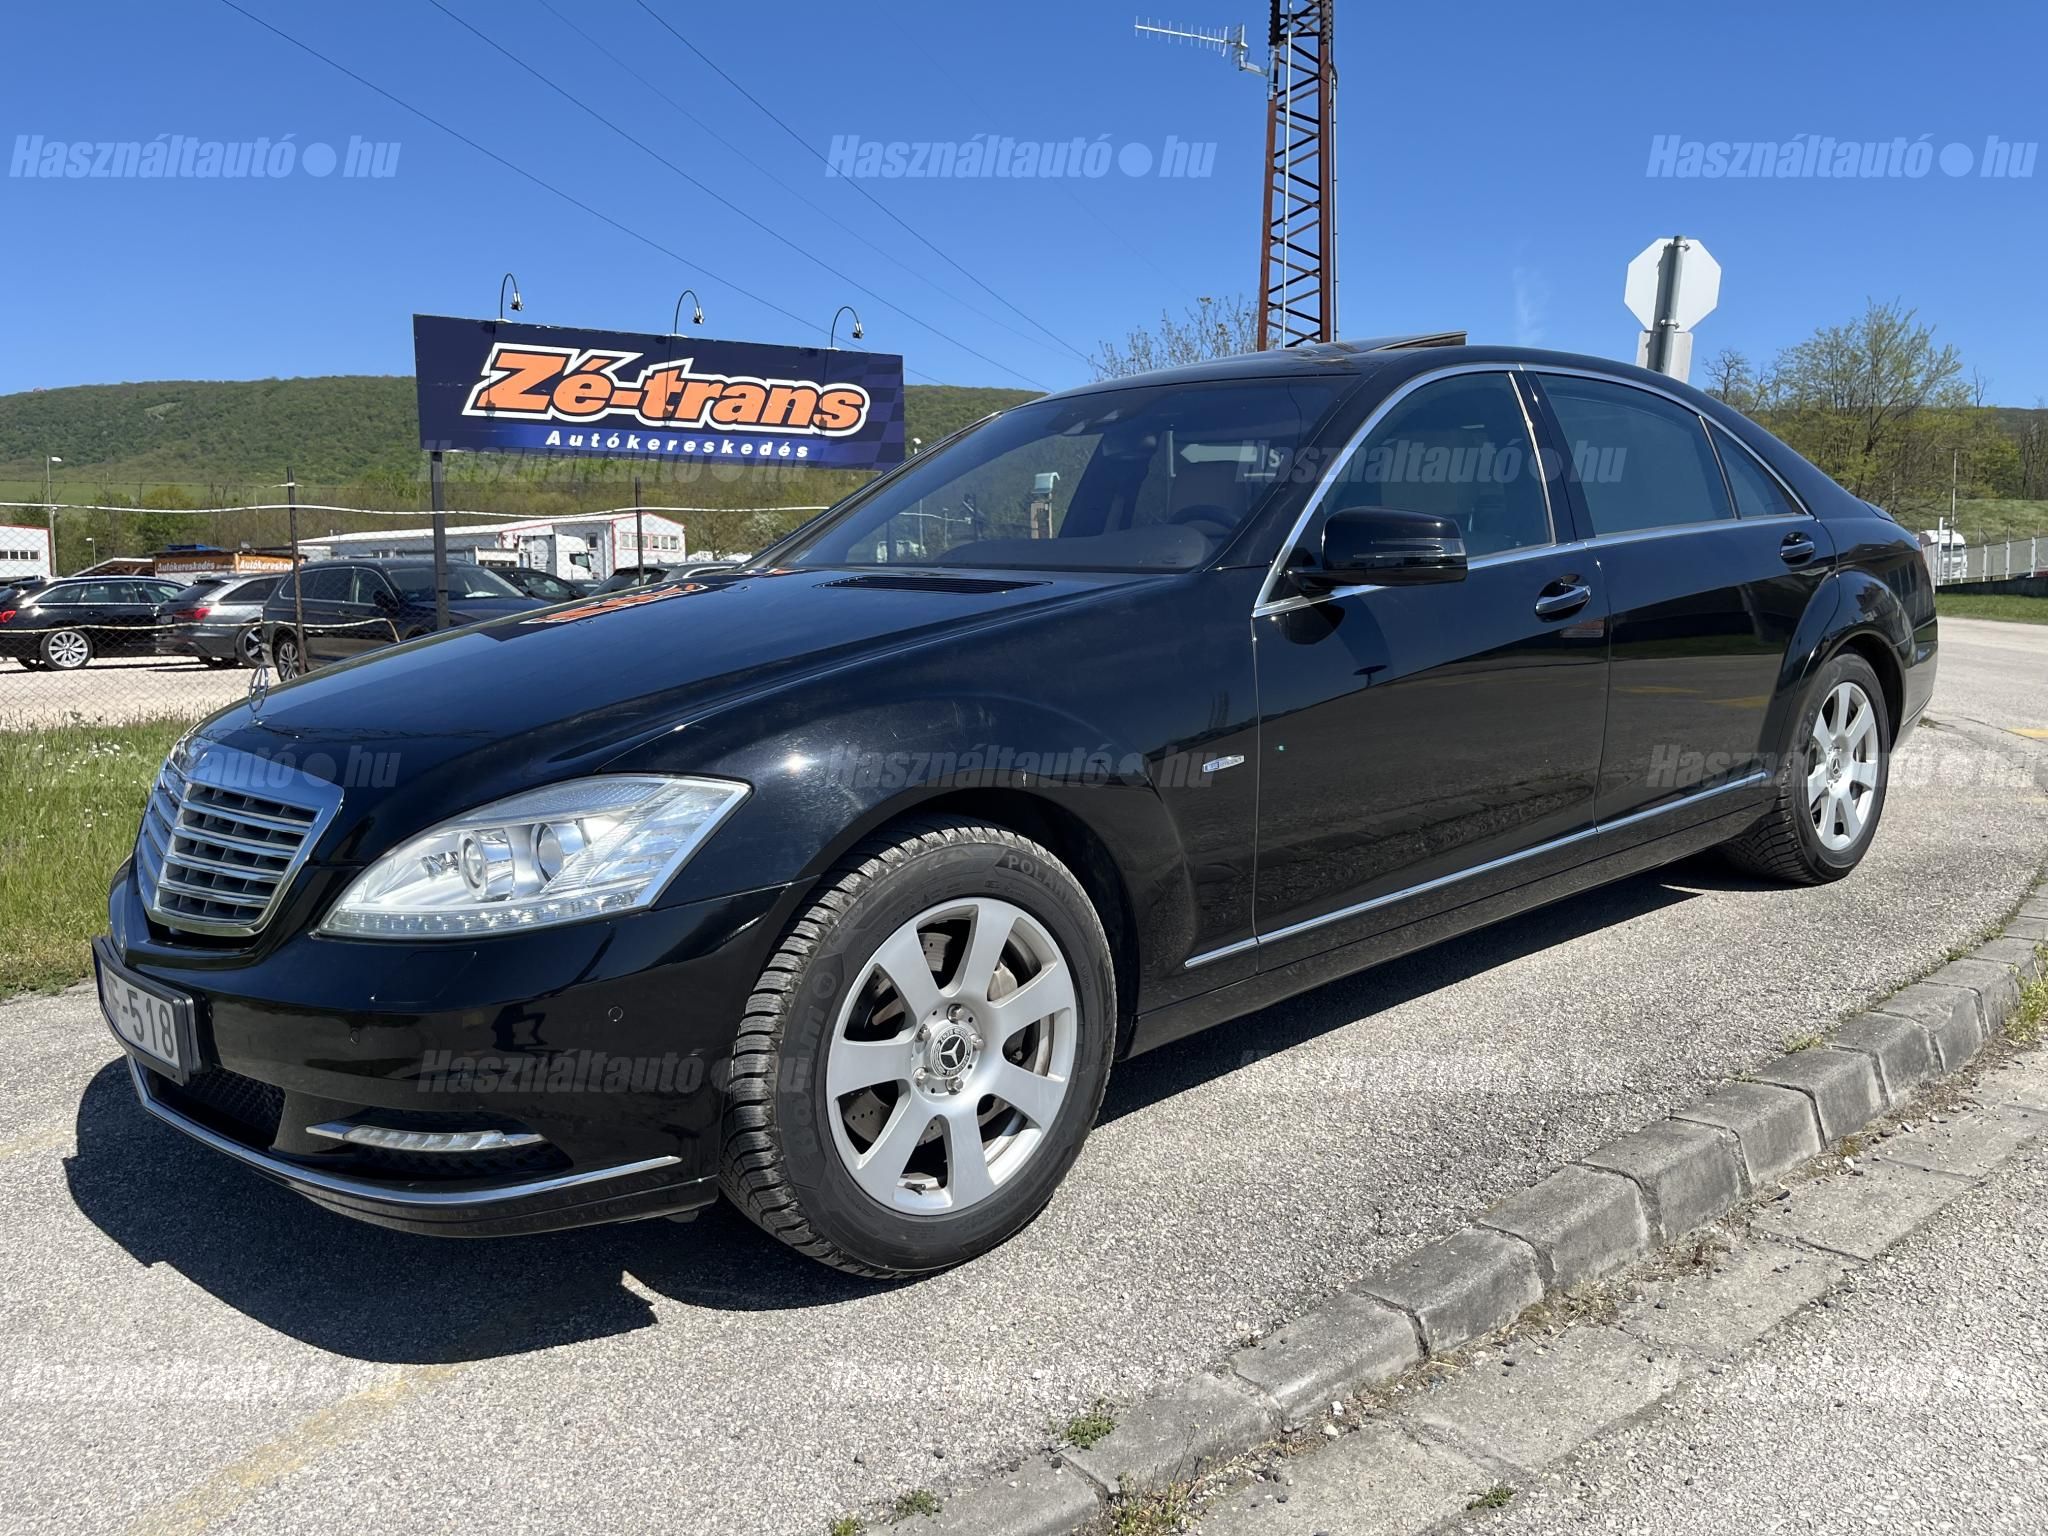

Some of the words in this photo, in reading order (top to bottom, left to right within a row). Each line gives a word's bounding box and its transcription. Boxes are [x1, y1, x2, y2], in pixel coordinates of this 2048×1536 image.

[468, 345, 869, 433] Zé-trans
[546, 430, 809, 458] Autókereskedés
[239, 560, 294, 570] Autókeresked
